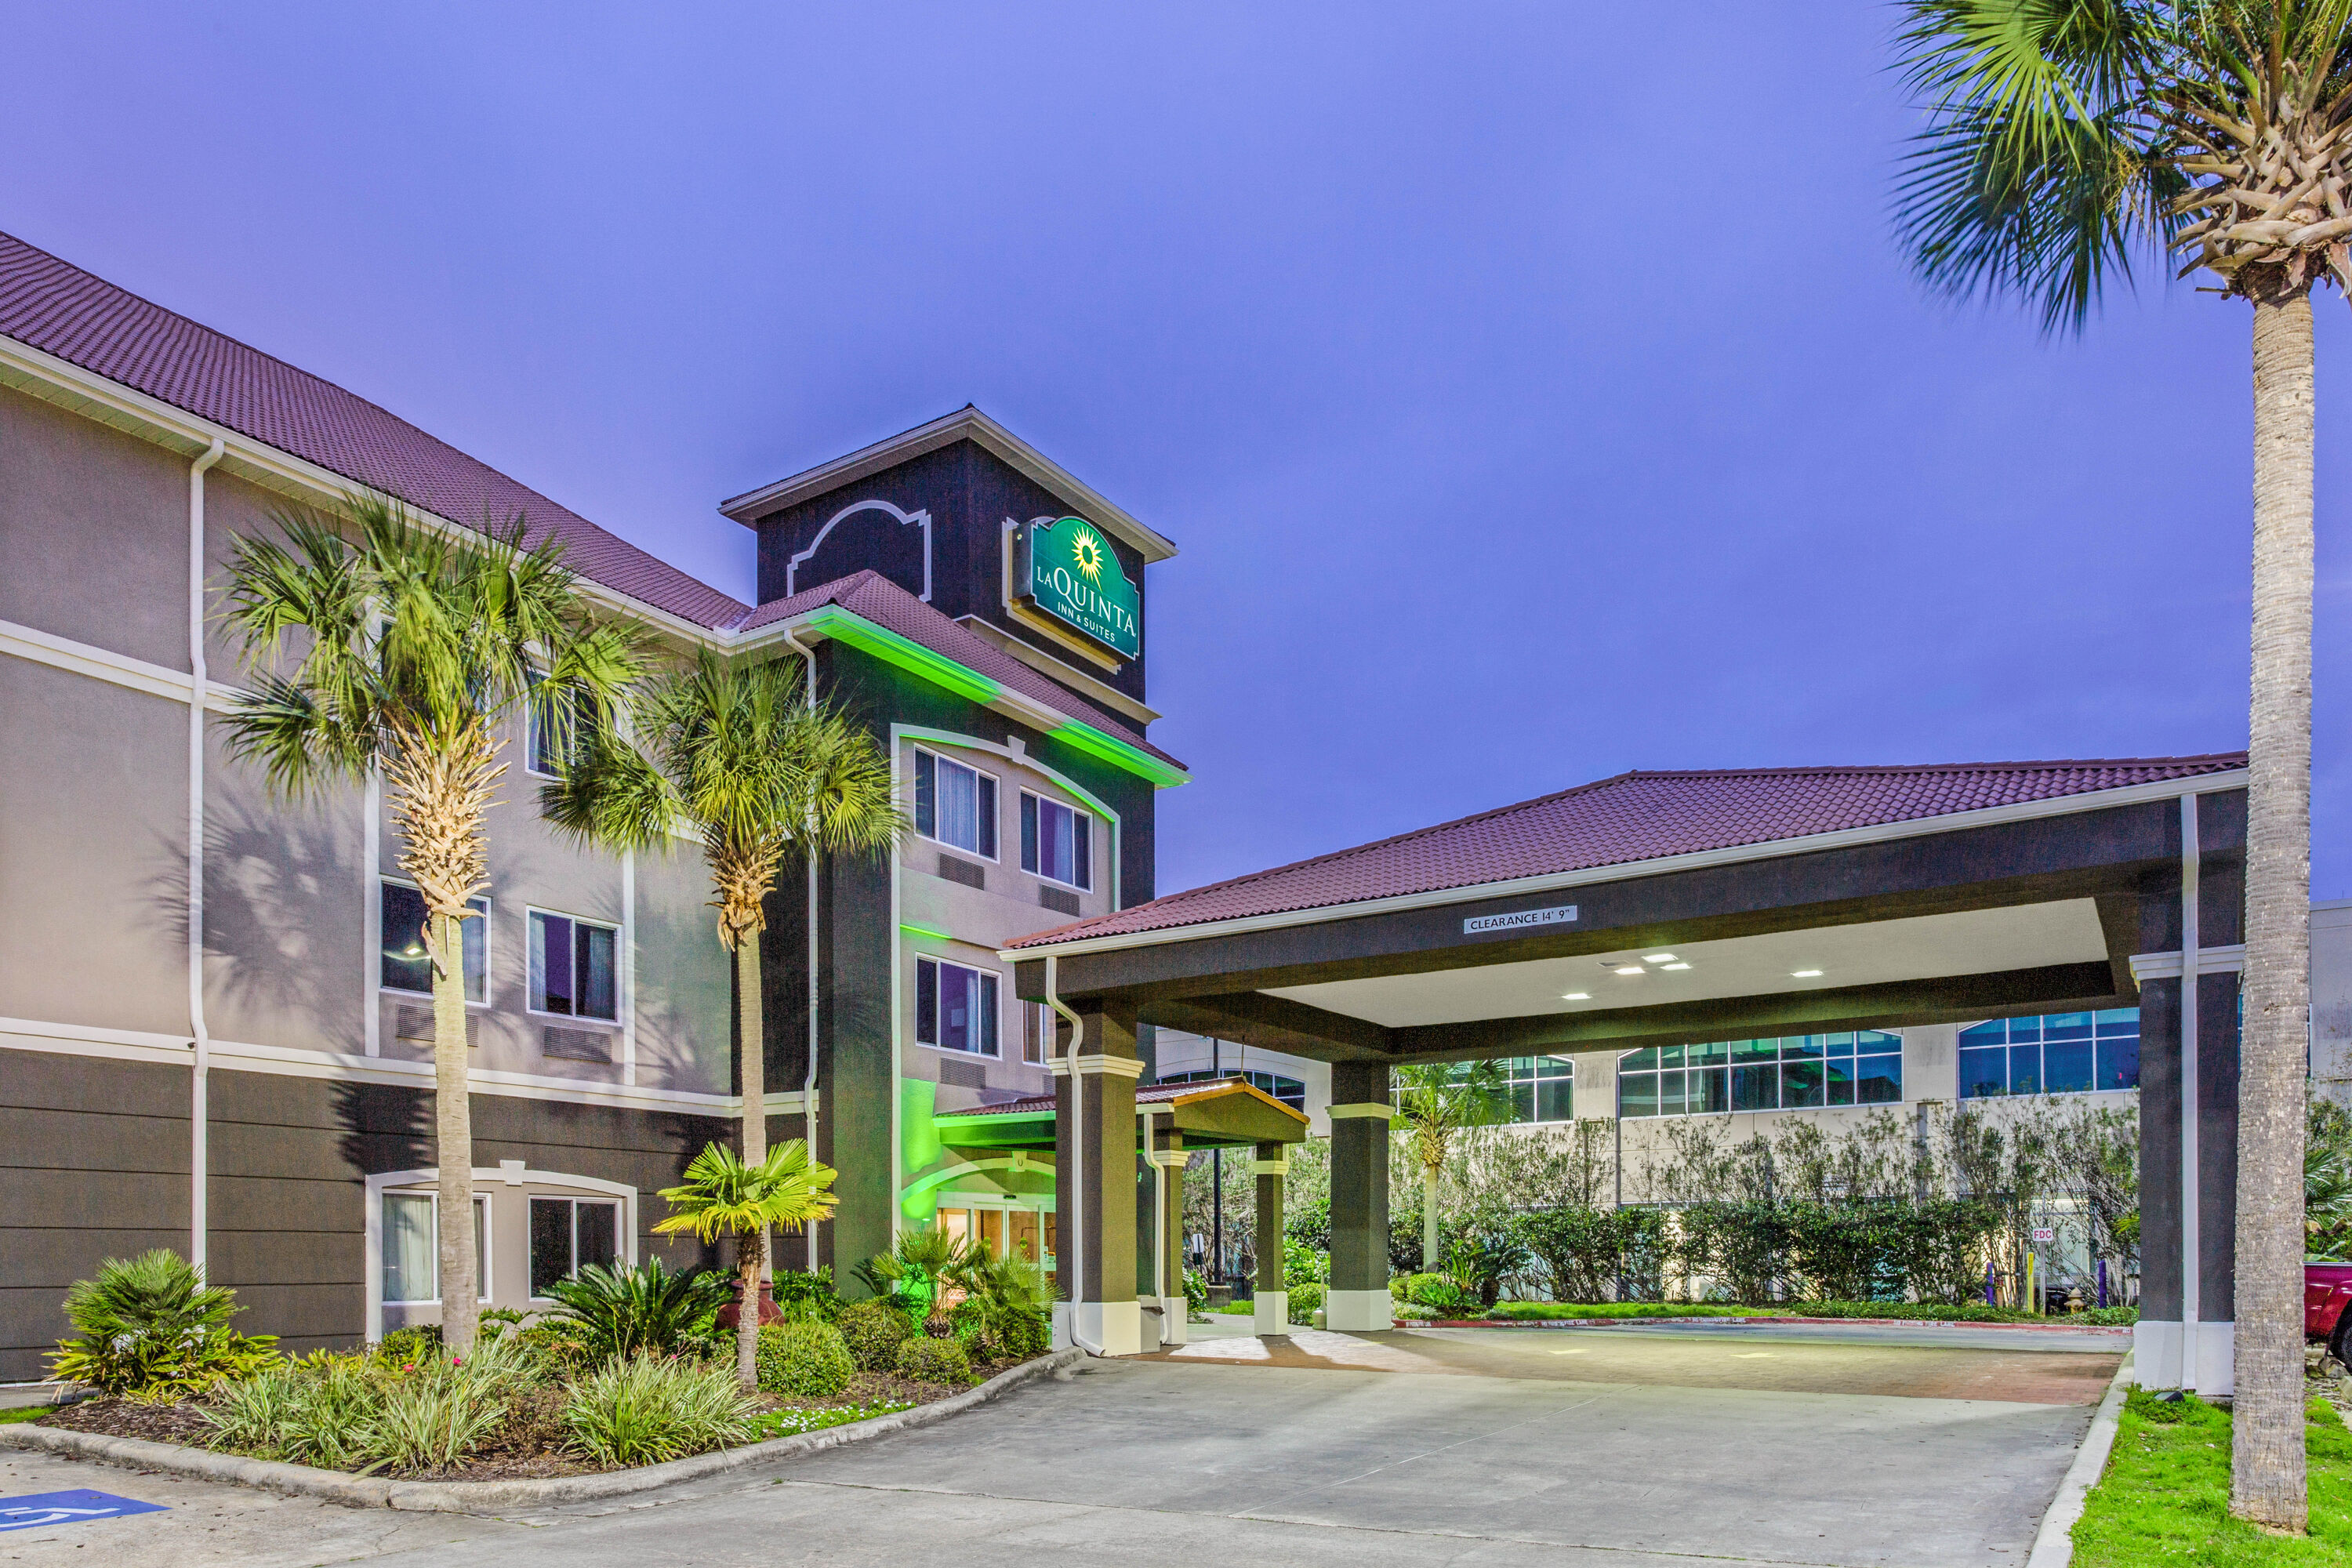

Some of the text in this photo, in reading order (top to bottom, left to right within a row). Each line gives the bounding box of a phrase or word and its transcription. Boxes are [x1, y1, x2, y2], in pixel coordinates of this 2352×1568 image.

[1036, 565, 1136, 637] LA QUINTA
[1058, 601, 1116, 643] INN & SUITES
[1470, 913, 1538, 930] CLEARANCE
[2034, 1229, 2052, 1239] FDC
